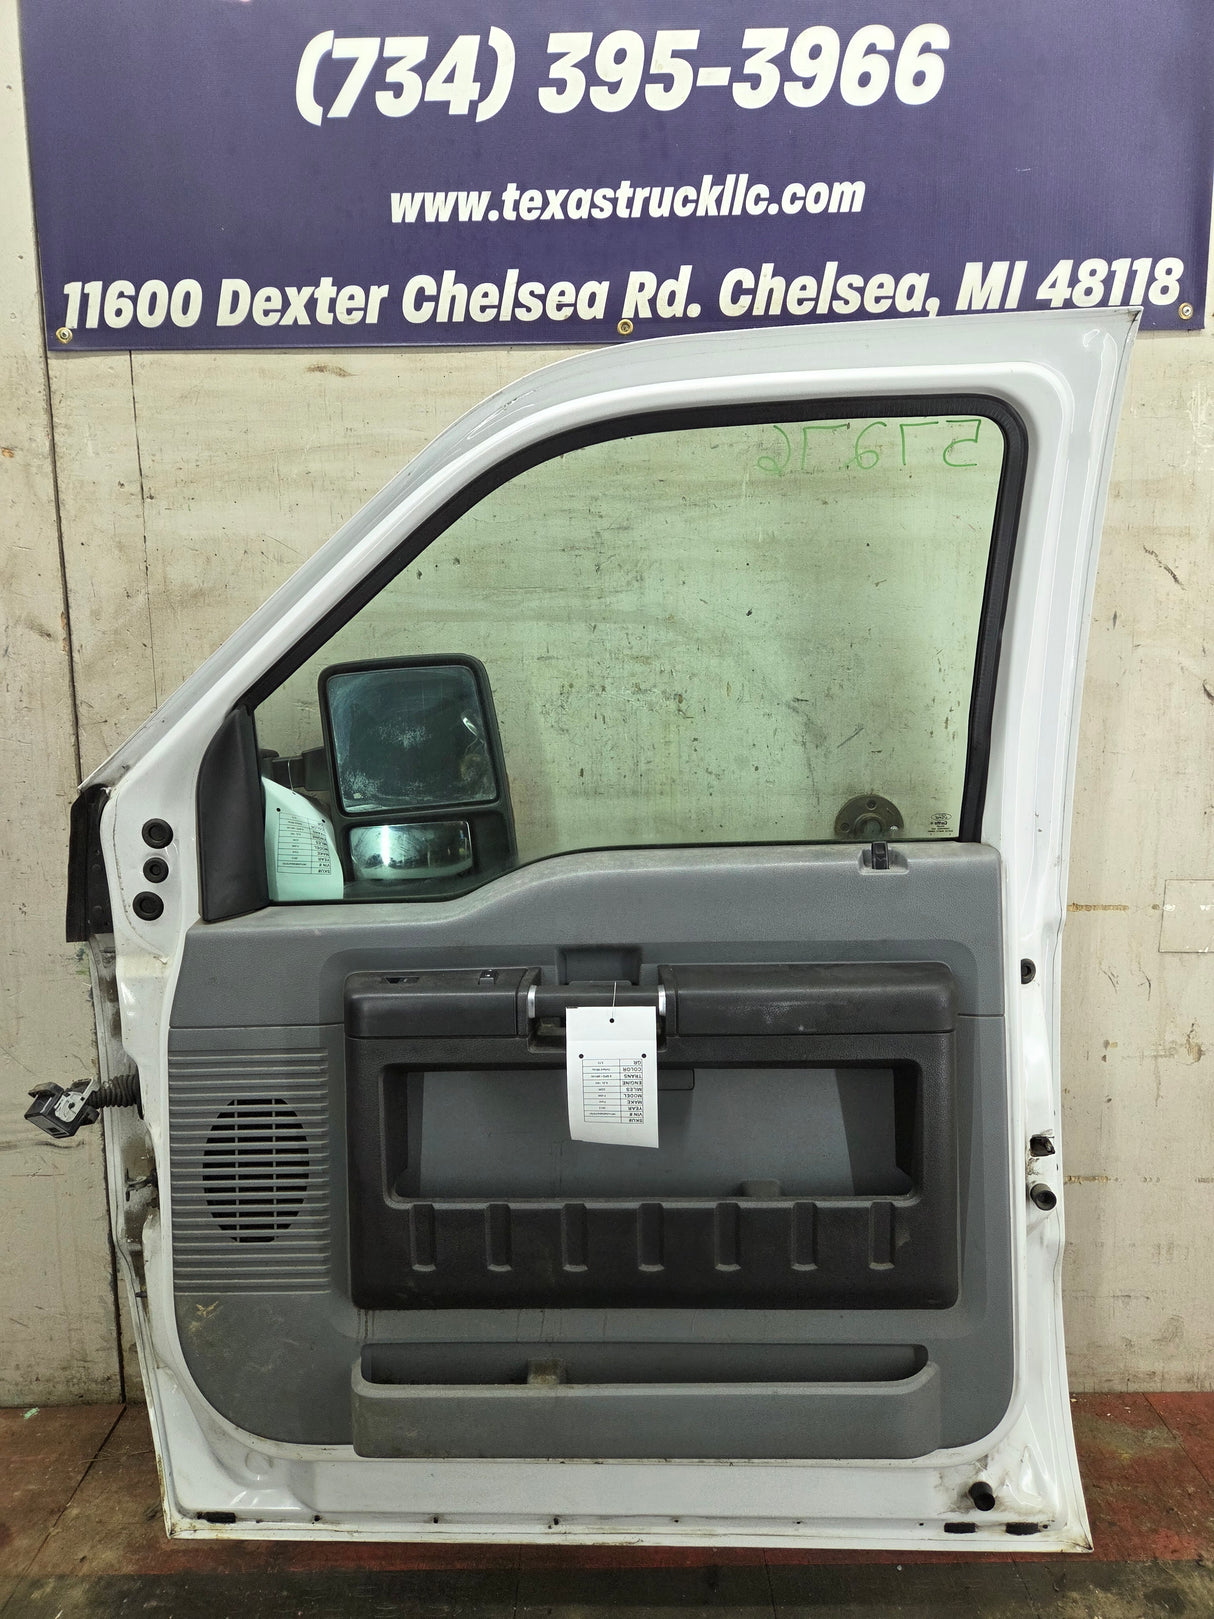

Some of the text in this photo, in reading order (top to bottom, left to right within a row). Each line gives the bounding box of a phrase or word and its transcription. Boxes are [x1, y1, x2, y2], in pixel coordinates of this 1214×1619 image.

[296, 23, 950, 126] (734) 395-3966
[391, 174, 865, 223] www.texastruckllc.com
[62, 258, 1184, 329] 11600 Dexter Chelsea Rd. Chelsea, MI 48118
